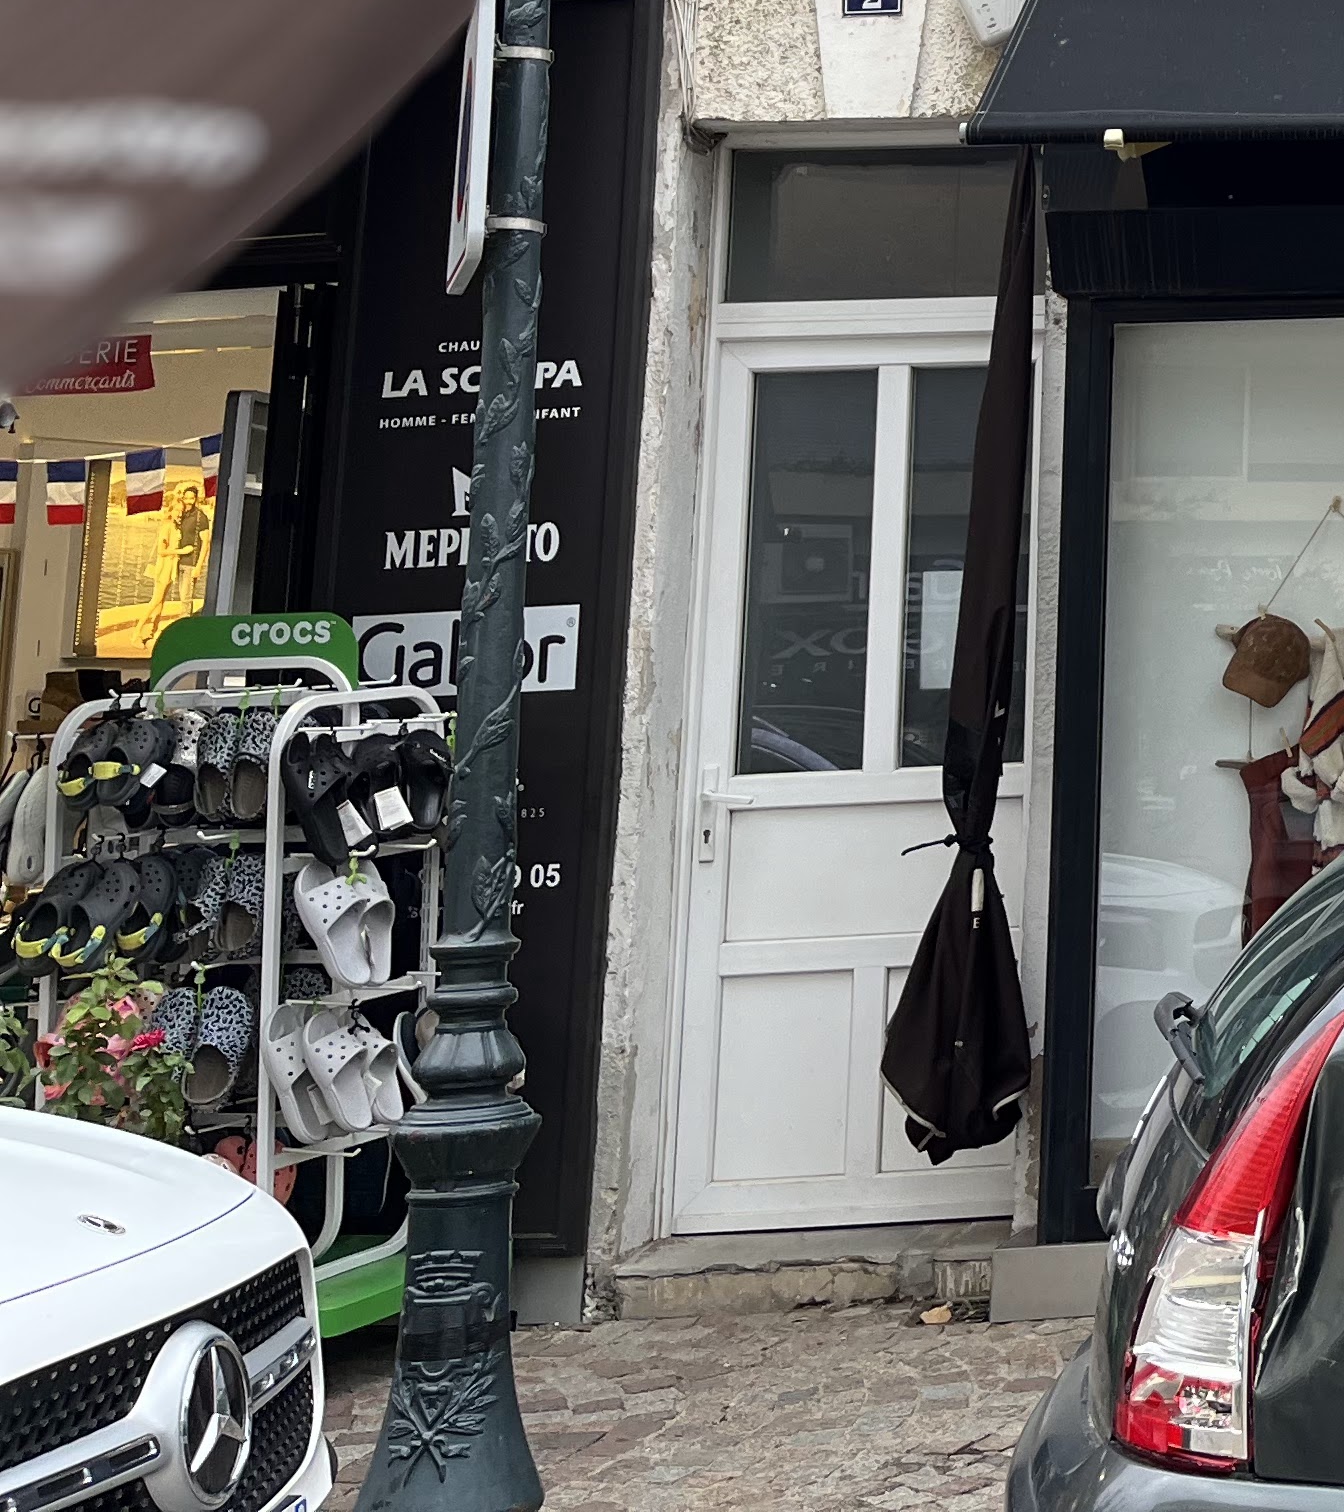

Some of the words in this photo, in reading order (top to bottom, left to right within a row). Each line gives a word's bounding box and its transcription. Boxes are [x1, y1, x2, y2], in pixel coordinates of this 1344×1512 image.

[438, 341, 480, 353] CHAU
[381, 369, 429, 399] LA
[439, 360, 583, 395] SCPA
[379, 415, 436, 429] HOMME
[231, 619, 332, 647] crocs
[521, 808, 545, 818] 825
[530, 863, 560, 888] 05
